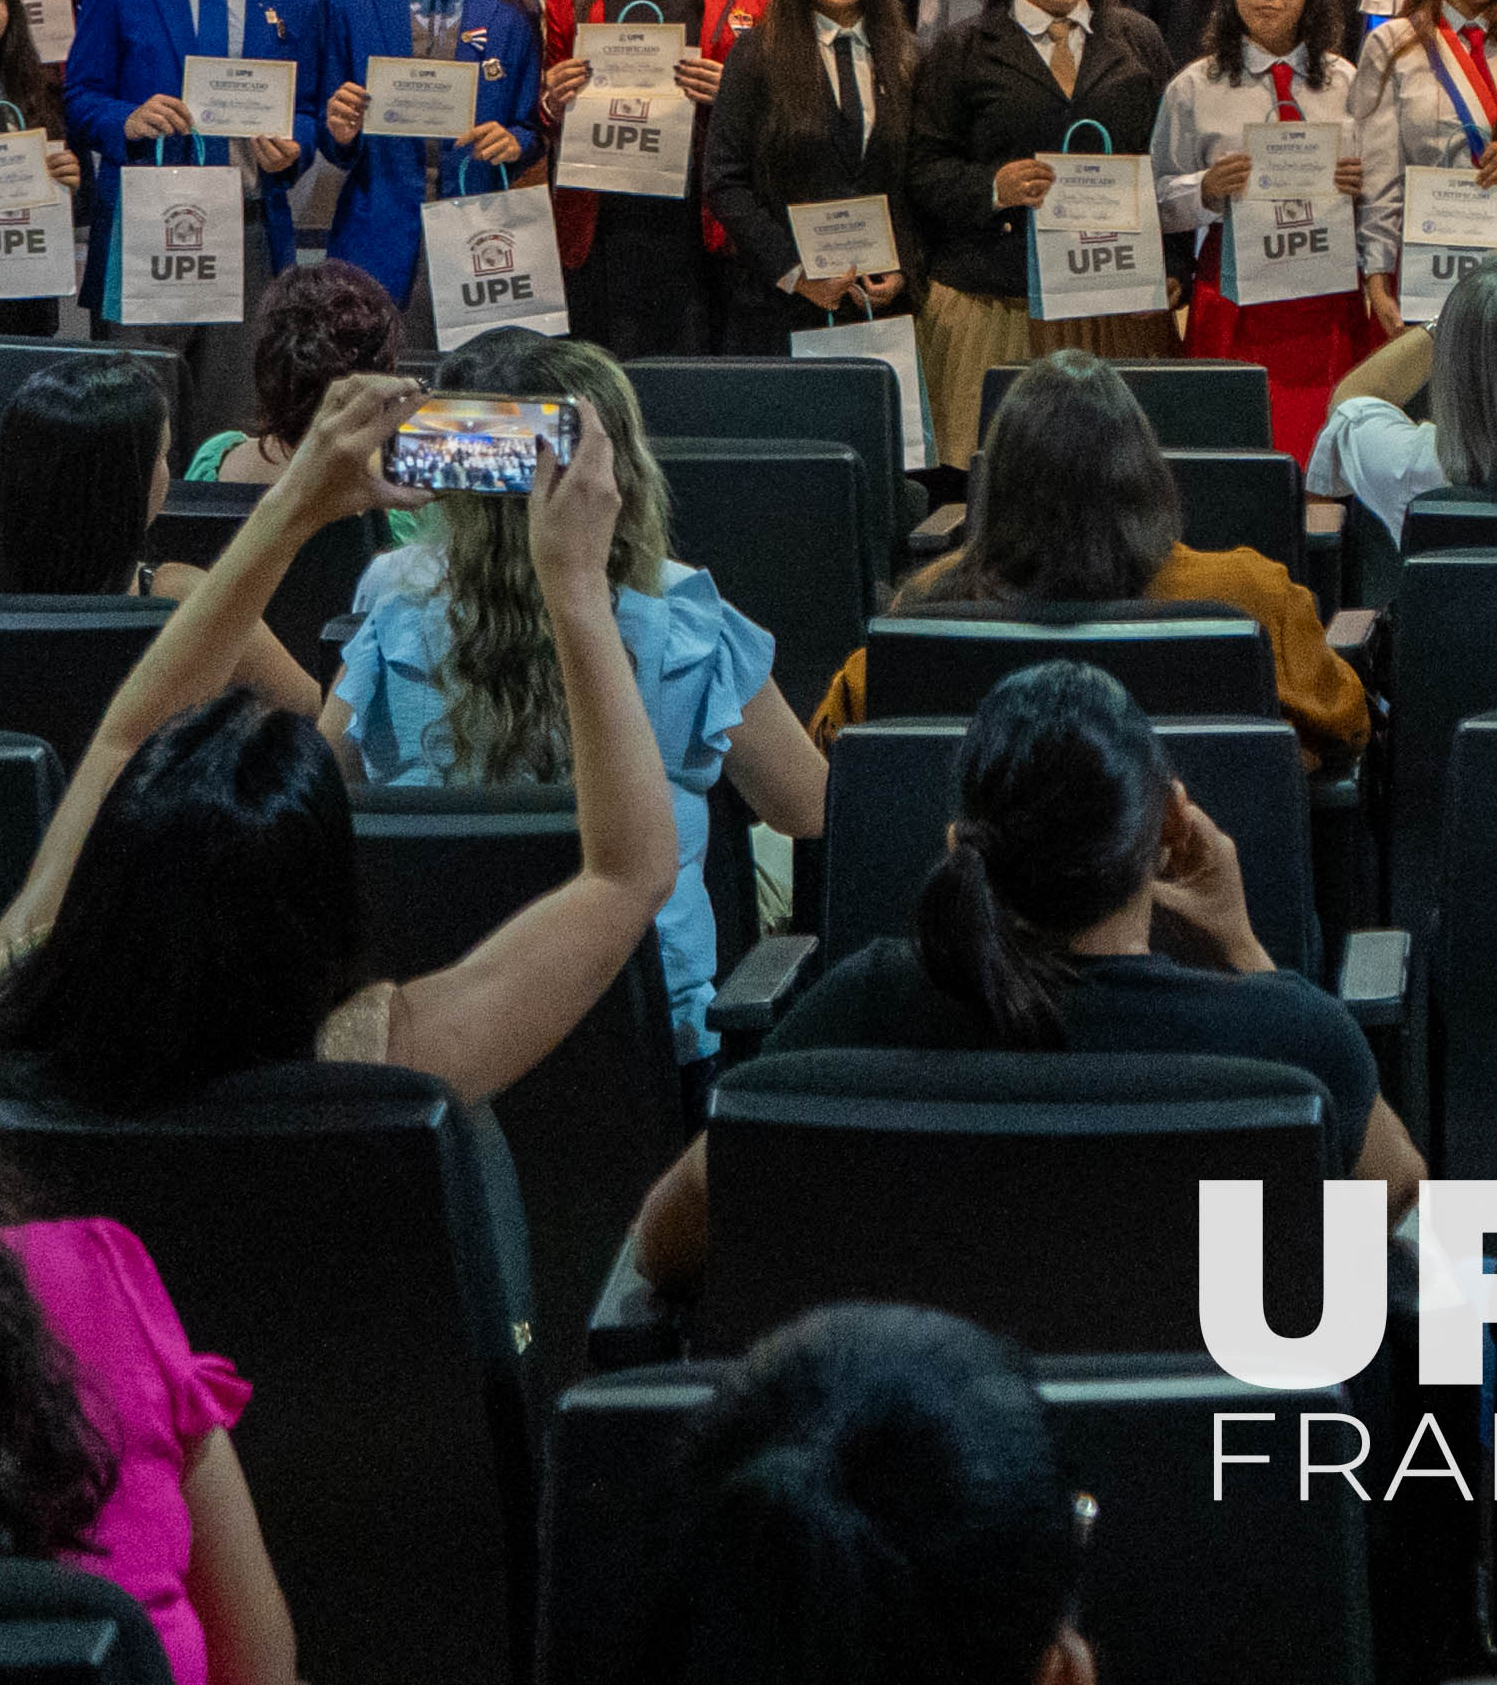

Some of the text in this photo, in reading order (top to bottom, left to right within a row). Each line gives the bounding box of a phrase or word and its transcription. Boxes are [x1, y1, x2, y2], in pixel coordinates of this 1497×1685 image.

[592, 124, 660, 153] UPE
[1264, 228, 1329, 258] UPE
[151, 255, 216, 280] UPE
[1068, 246, 1135, 274] UPE
[1433, 256, 1479, 280] UP
[462, 275, 533, 307] UPE
